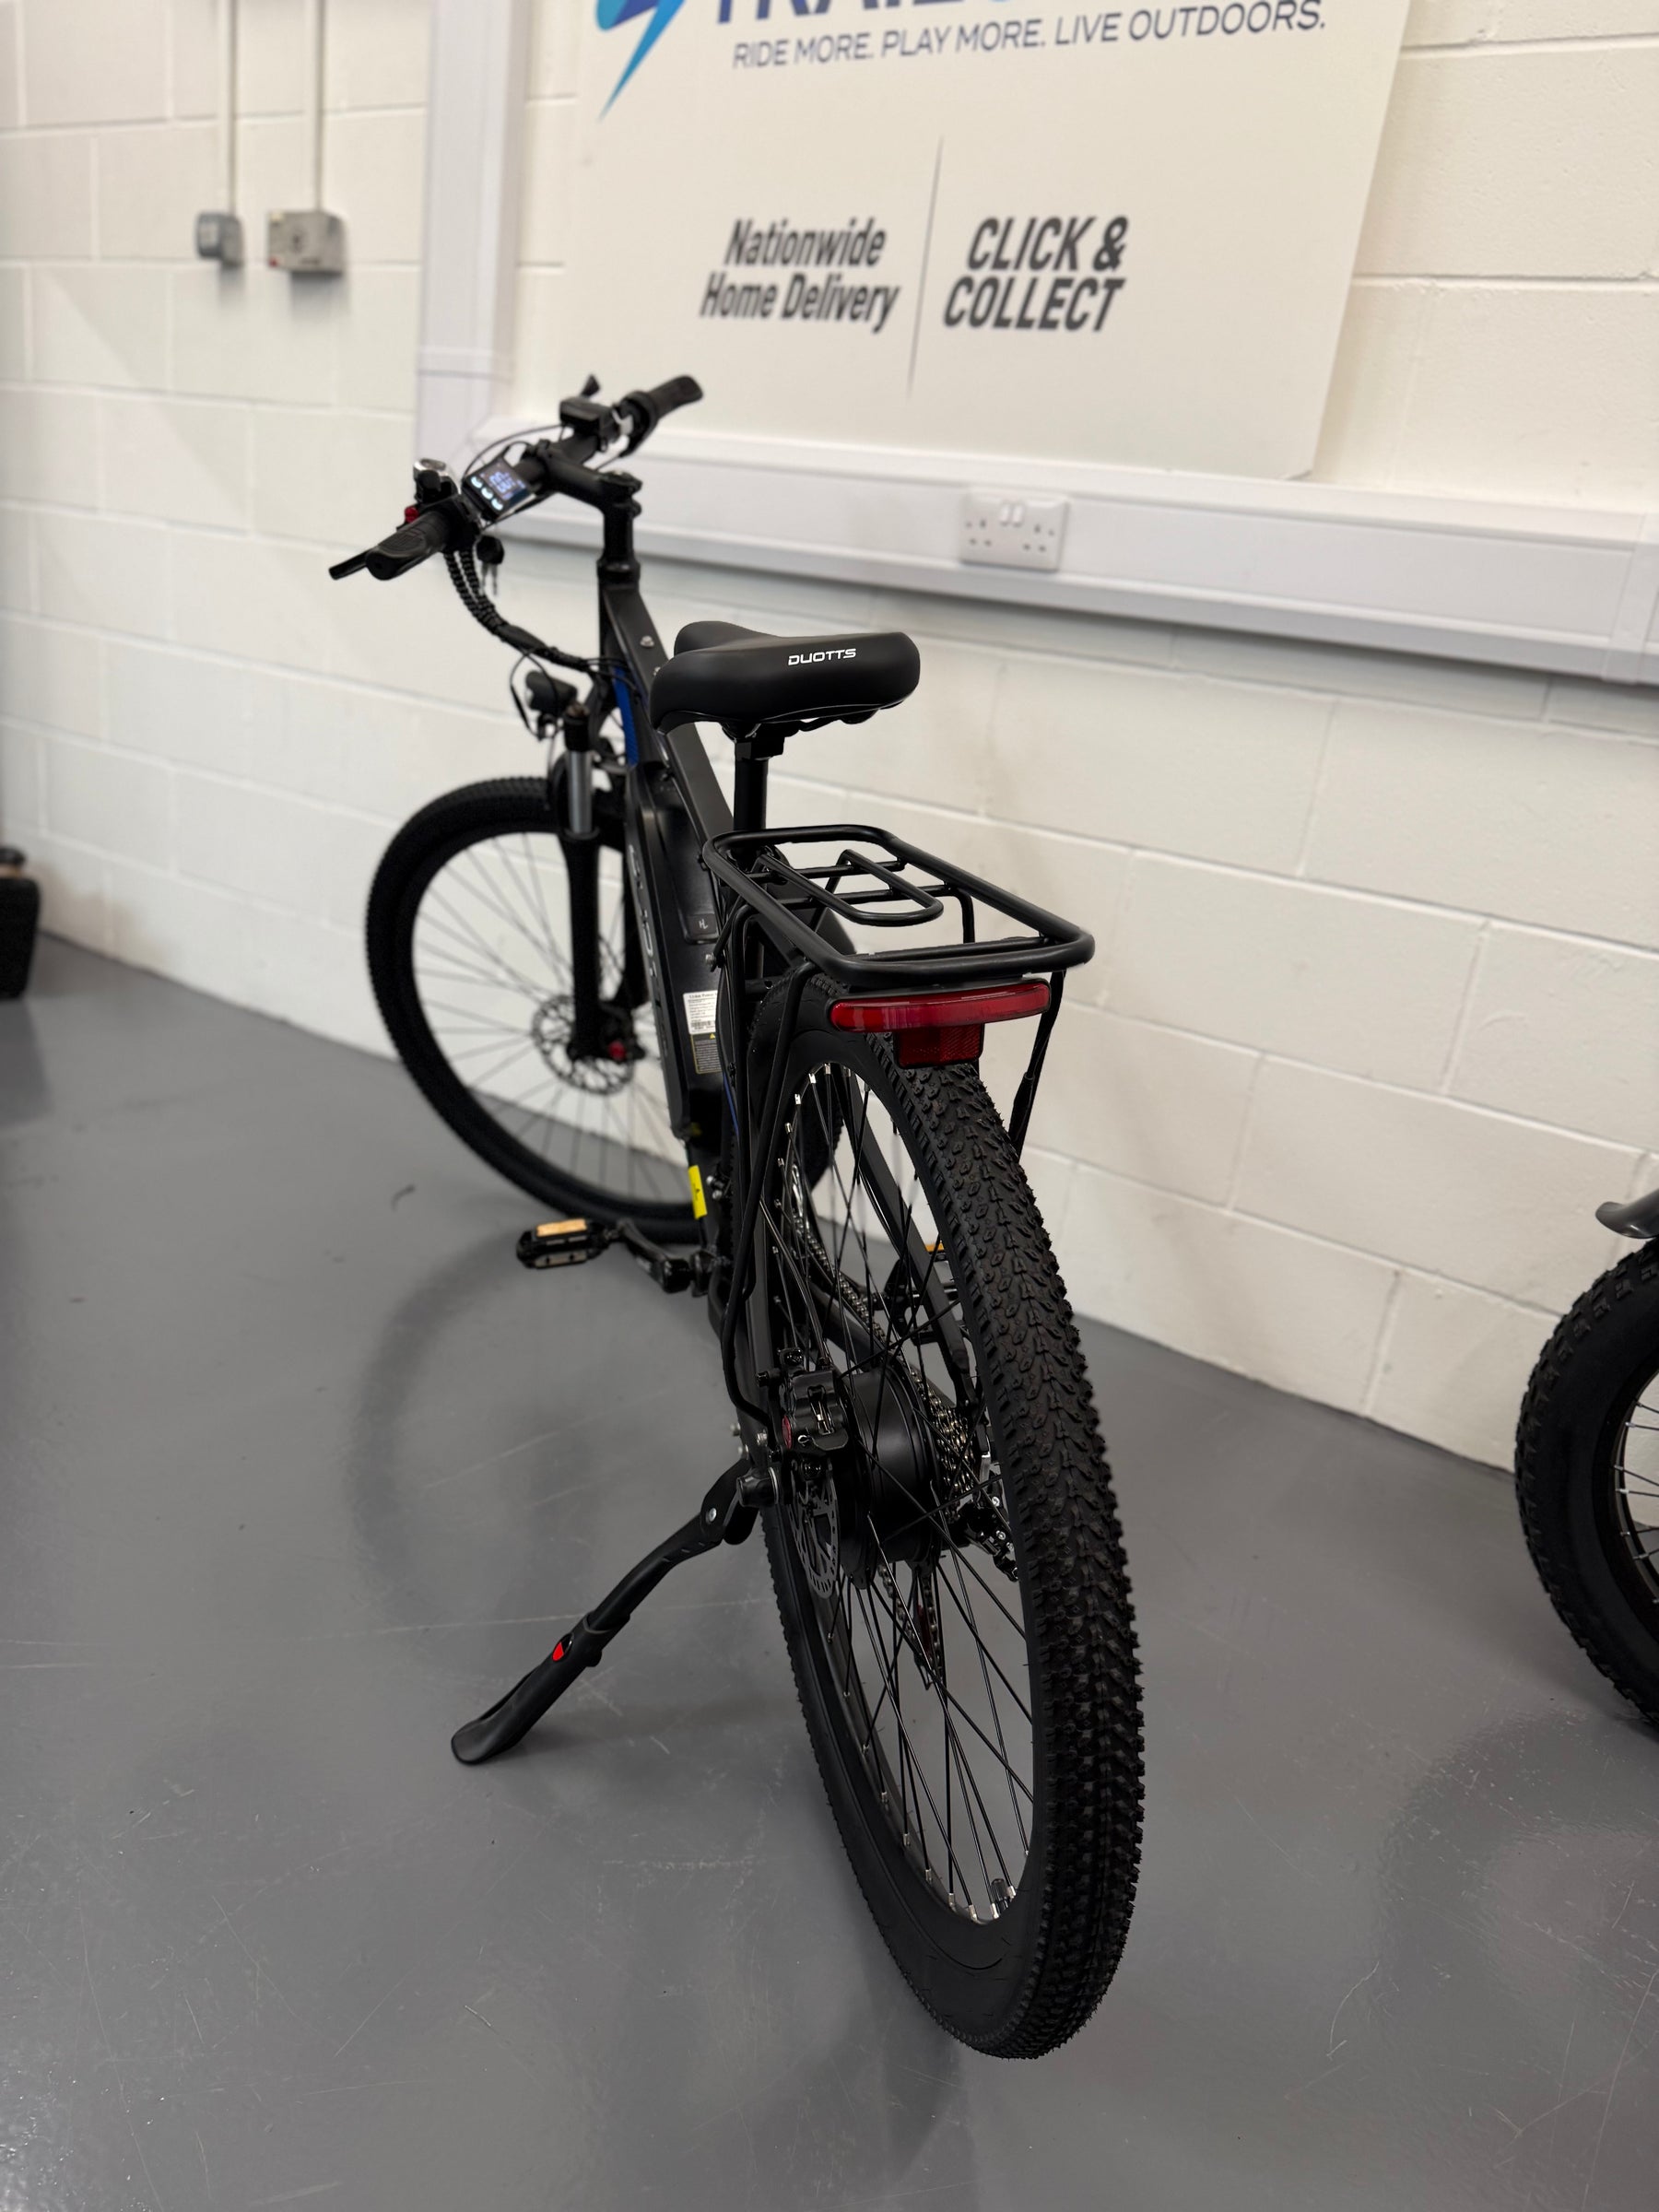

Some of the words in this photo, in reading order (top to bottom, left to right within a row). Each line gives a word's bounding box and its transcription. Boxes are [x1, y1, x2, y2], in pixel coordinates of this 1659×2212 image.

[733, 39, 789, 68] RIDE
[794, 32, 874, 65] MORE.
[881, 26, 951, 57] PLAY
[955, 18, 1046, 53] MORE.
[1055, 12, 1122, 45] LIVE
[1129, 0, 1325, 41] OUTDOORS.
[724, 217, 887, 266] Nationwide
[967, 217, 1097, 271] CLICK
[1092, 216, 1128, 271] &
[700, 272, 778, 319] Home
[782, 273, 900, 334] Delivery
[943, 276, 1126, 332] COLLECT
[788, 648, 857, 665] DUOTTS
